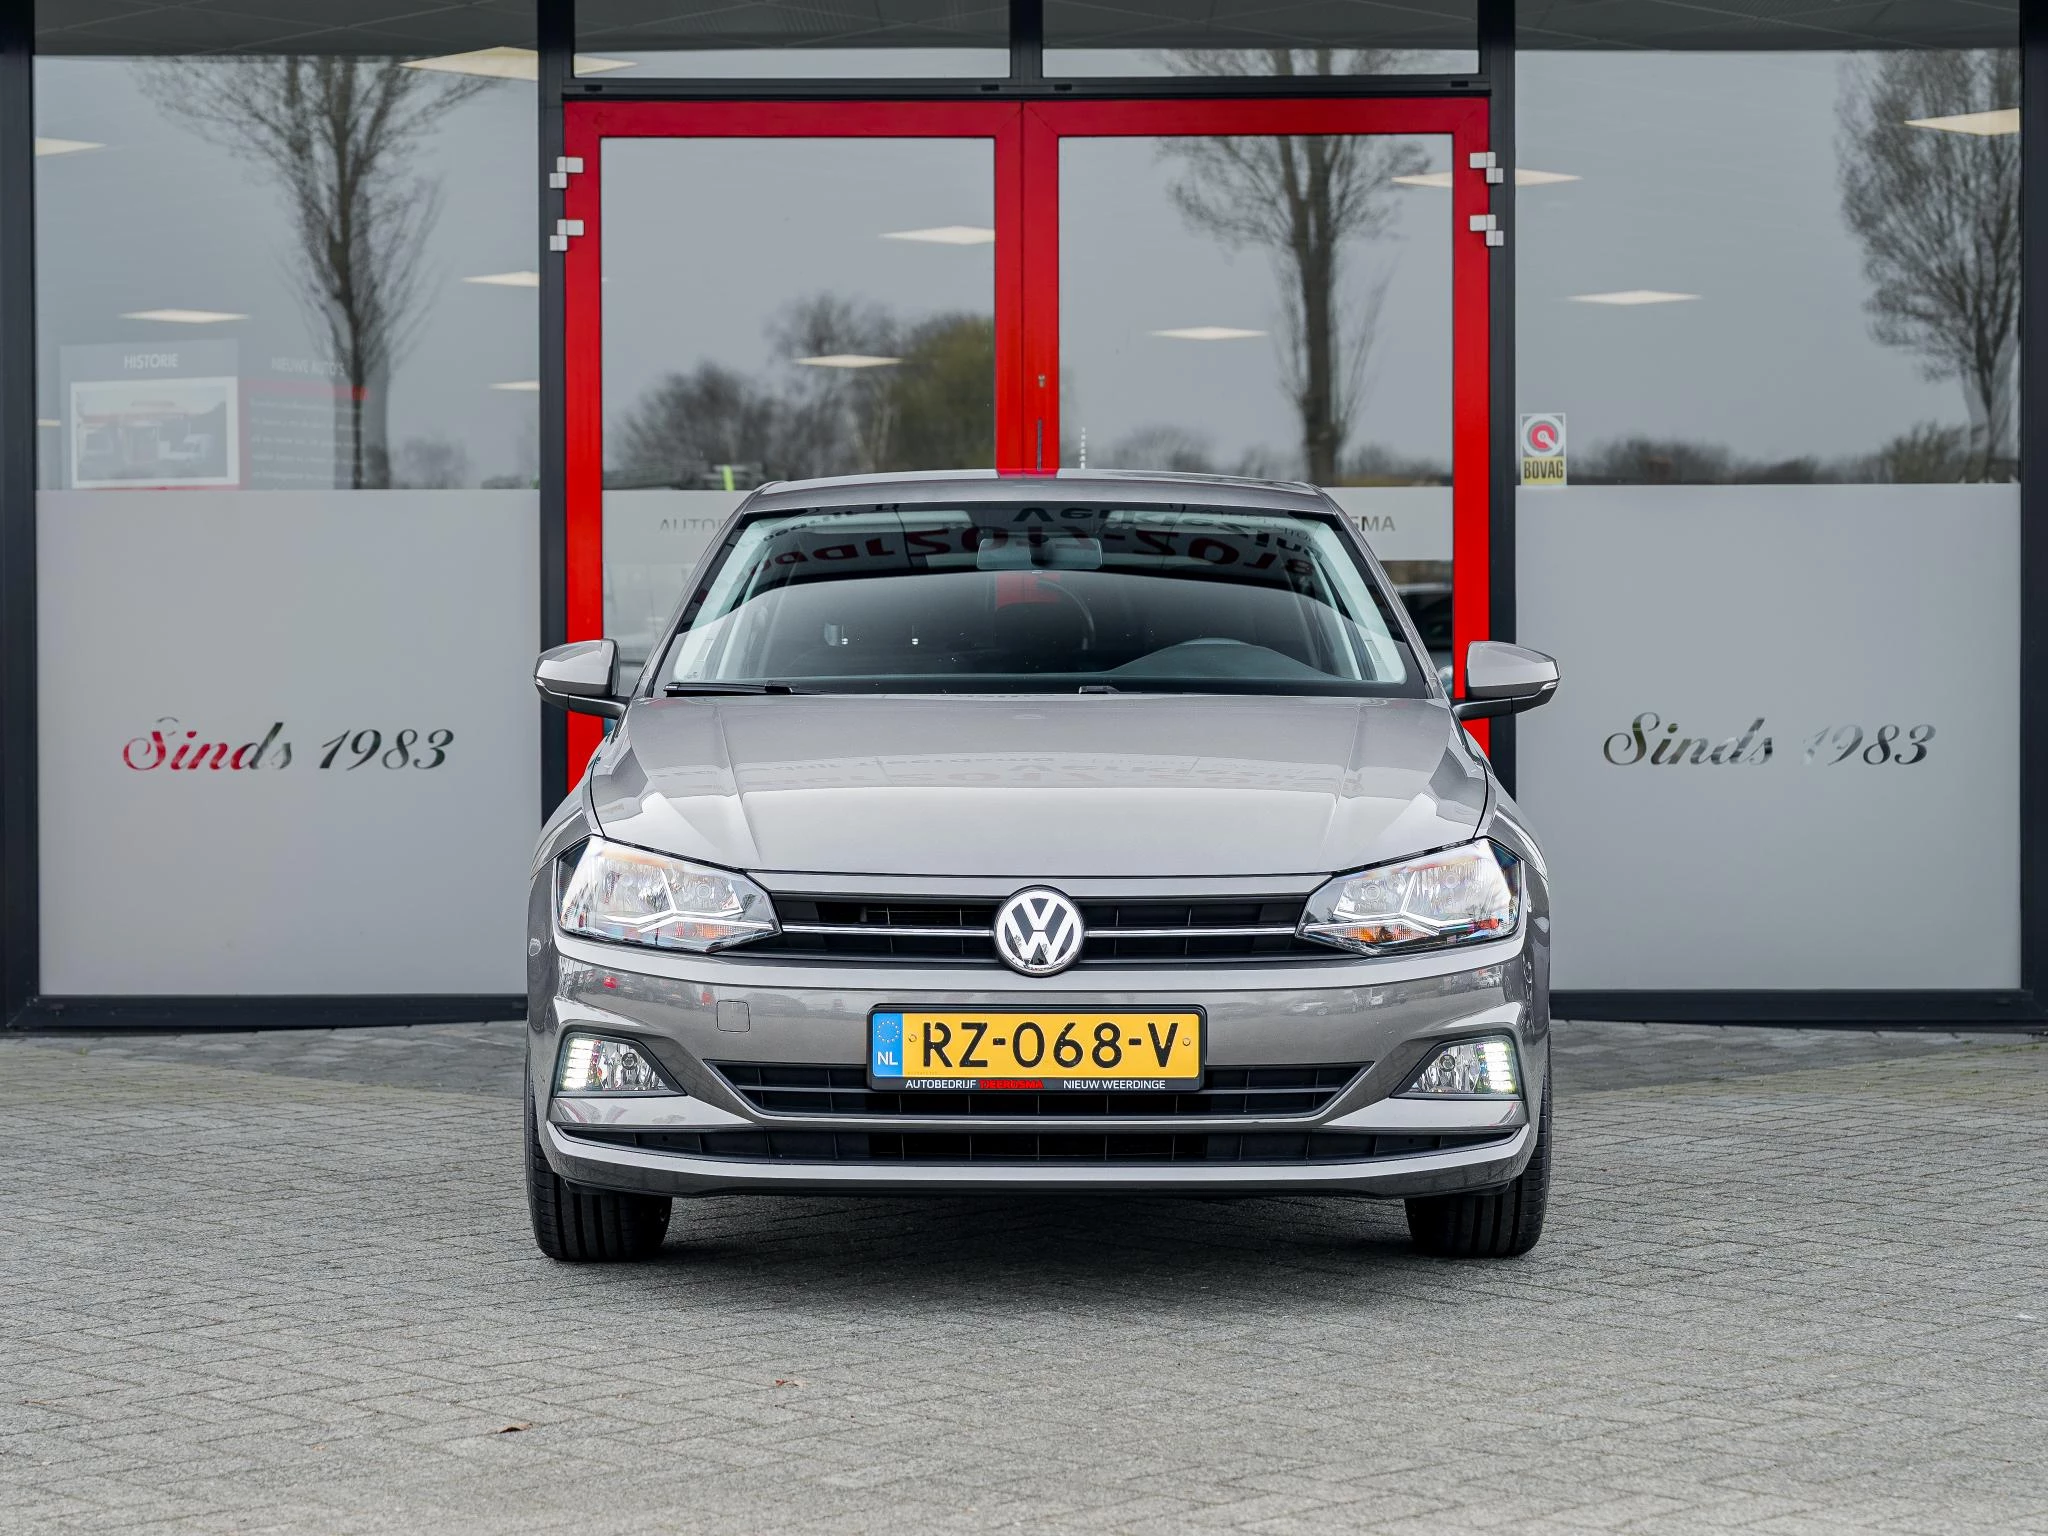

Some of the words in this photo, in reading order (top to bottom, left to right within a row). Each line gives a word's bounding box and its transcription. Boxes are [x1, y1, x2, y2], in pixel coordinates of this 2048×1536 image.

[124, 353, 179, 369] HISTORIE
[1523, 458, 1564, 480] BOVAG
[123, 716, 293, 772] Sinds
[318, 727, 455, 771] 1983
[1603, 711, 1774, 767] Sinds
[1803, 724, 1937, 767] 1983
[922, 1021, 1179, 1069] RZ-068-V
[877, 1051, 898, 1066] NL
[905, 1079, 977, 1089] AUTOBEDRIJF
[1063, 1079, 1099, 1089] NIEUW
[1102, 1079, 1166, 1089] WEERDINGE
